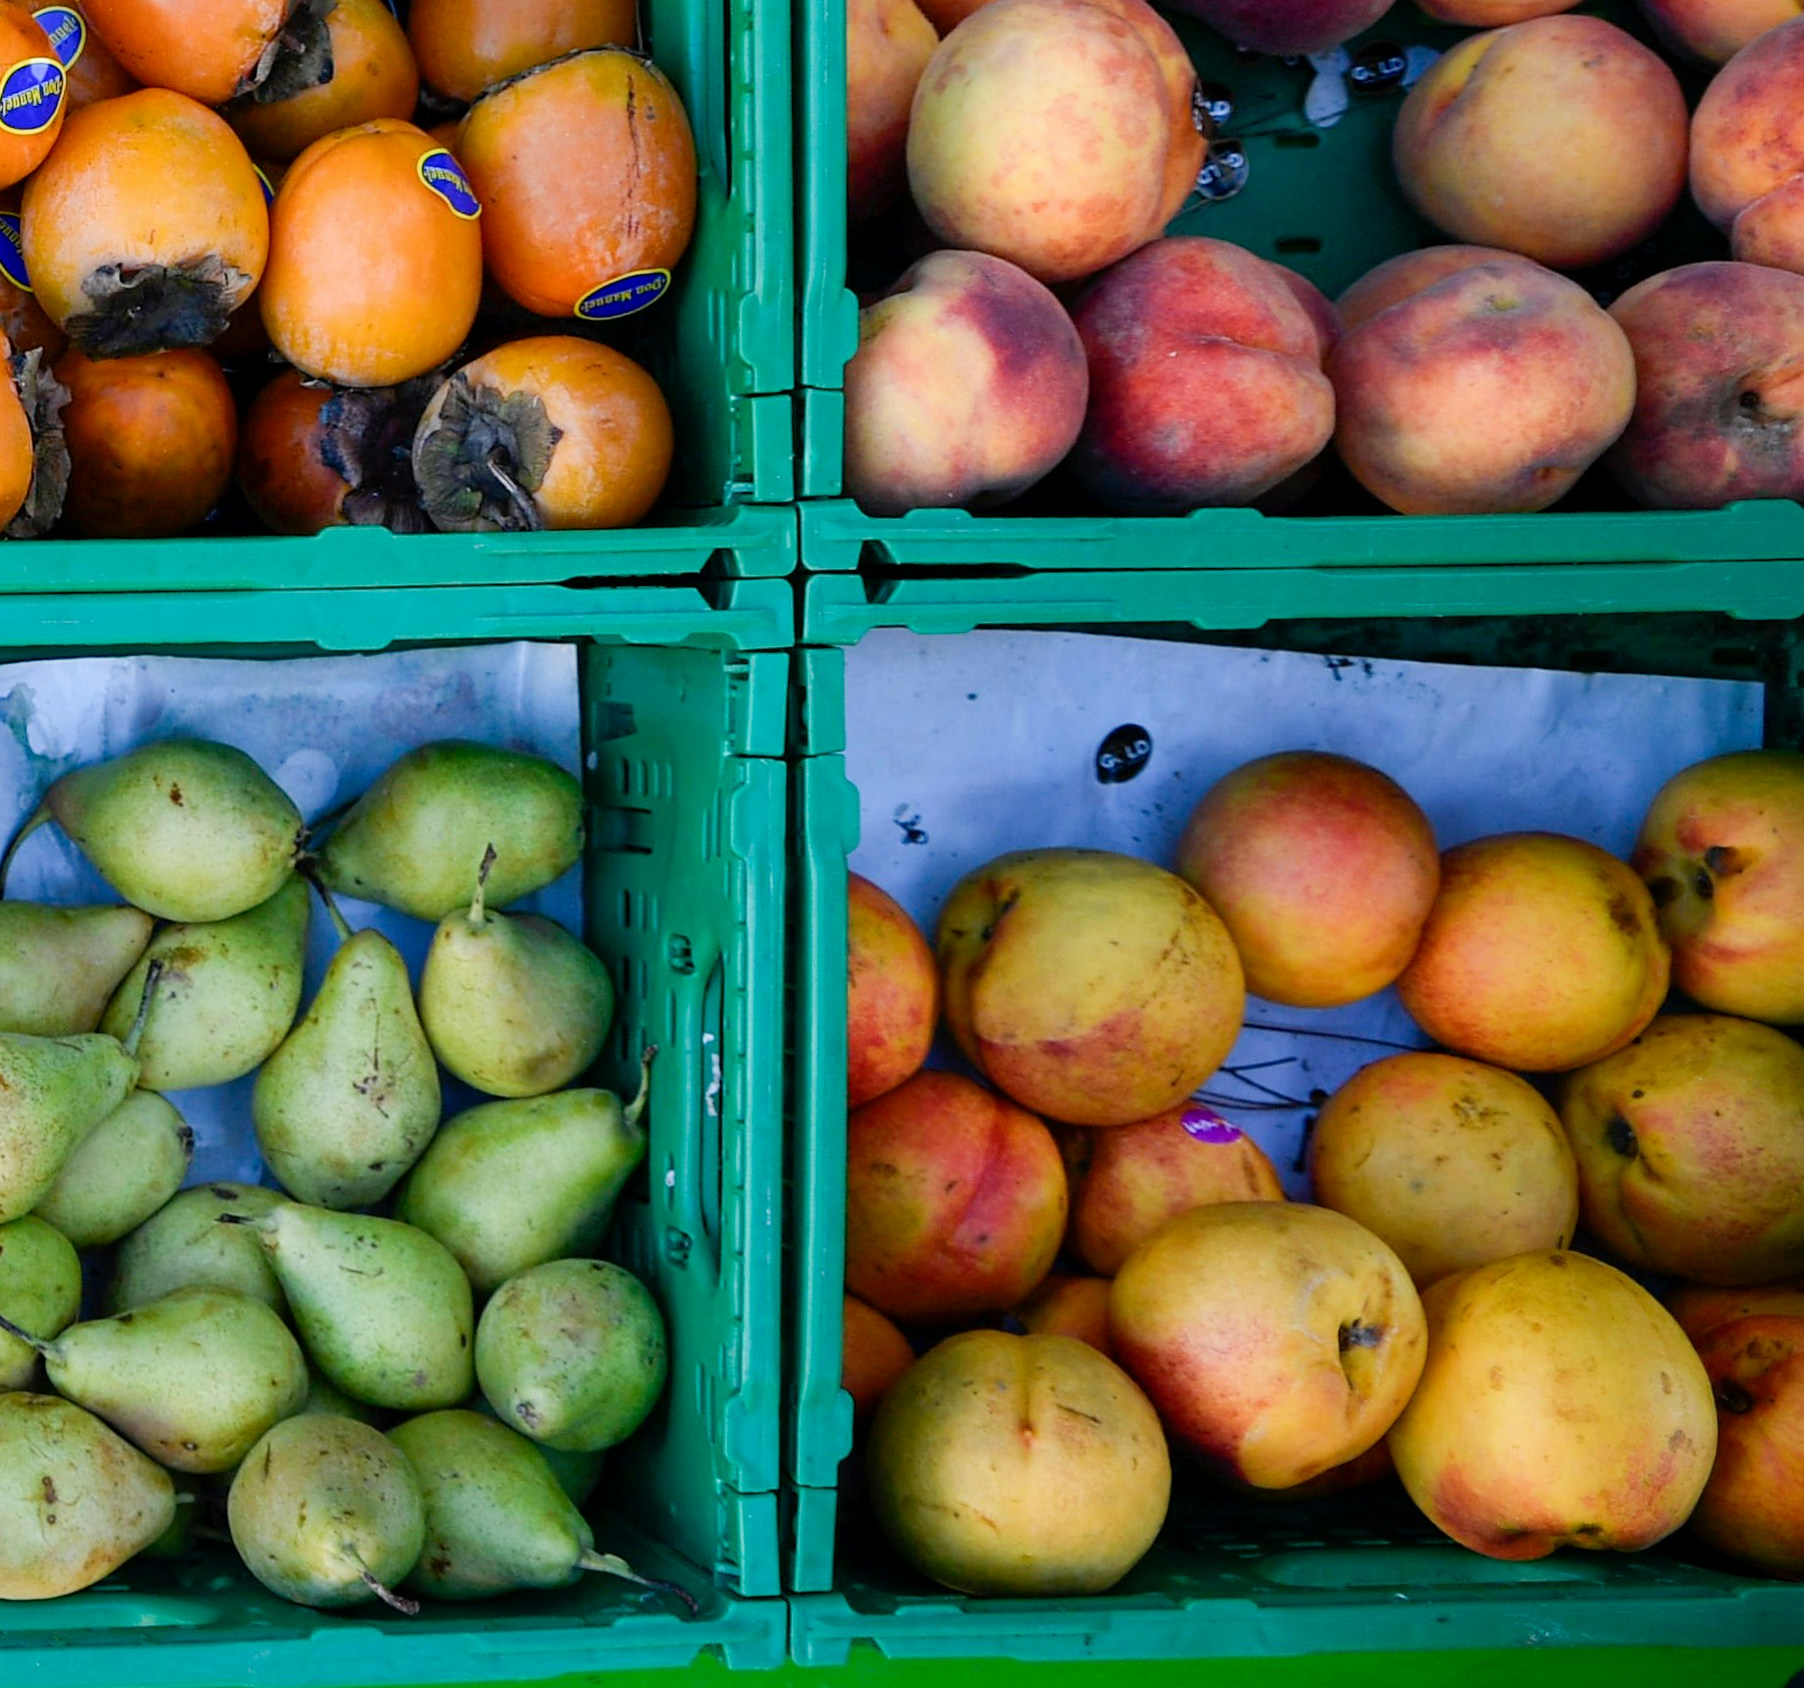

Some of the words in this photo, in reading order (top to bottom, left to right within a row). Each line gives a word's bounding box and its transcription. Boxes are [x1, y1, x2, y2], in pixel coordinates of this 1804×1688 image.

[48, 15, 77, 48] nuel
[1351, 58, 1405, 82] GLD
[42, 74, 61, 97] Don
[0, 85, 42, 117] Manuel
[636, 276, 666, 295] Don
[581, 288, 633, 313] Manuel
[1099, 739, 1150, 769] GLD
